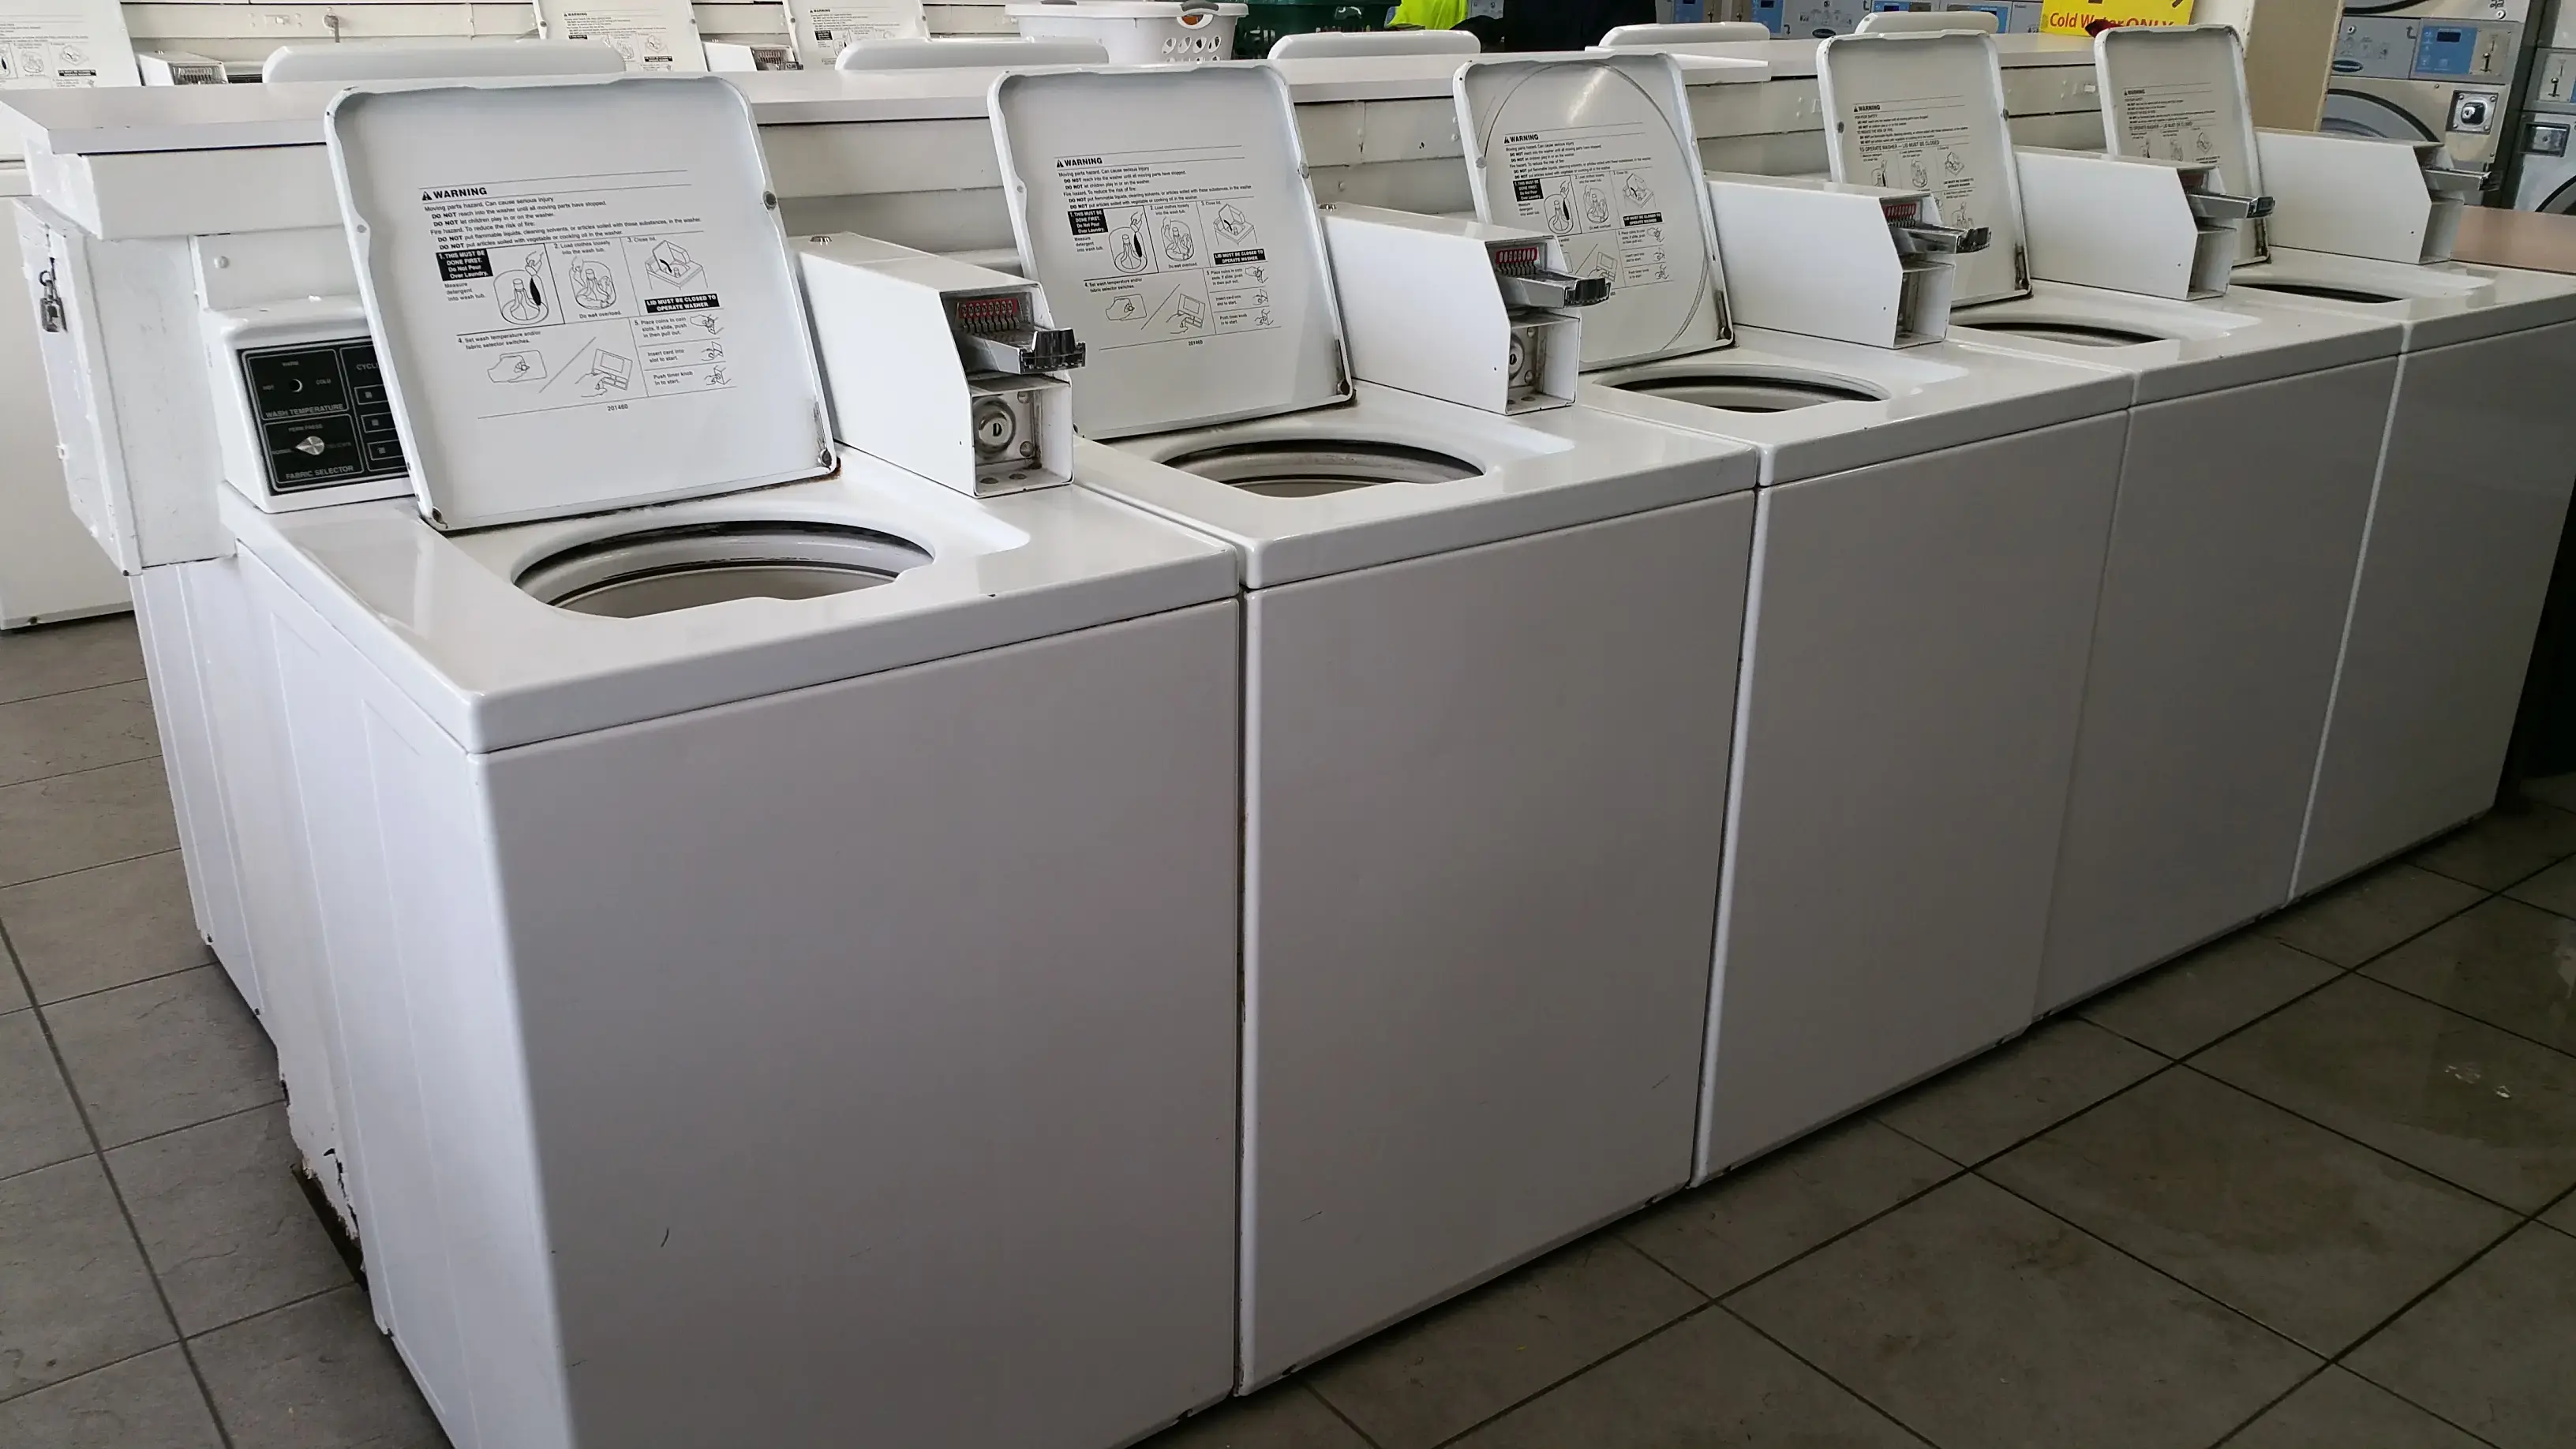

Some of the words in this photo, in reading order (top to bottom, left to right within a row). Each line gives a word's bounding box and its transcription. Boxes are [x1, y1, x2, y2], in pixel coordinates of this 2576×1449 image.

[2050, 13, 2078, 28] Cold
[2081, 14, 2124, 28] Wer
[1510, 134, 1539, 143] WARNING
[1064, 157, 1103, 167] WARNING
[433, 187, 487, 198] WARNING
[523, 228, 545, 237] cleaning
[526, 235, 551, 244] vegetable
[559, 233, 580, 241] cooking
[447, 288, 472, 296] detergent
[490, 332, 523, 341] temperature
[266, 409, 288, 418] WASH
[289, 403, 343, 415] TEMPERATURE
[285, 470, 314, 480] FABRIC
[315, 465, 354, 476] SELECTOR
